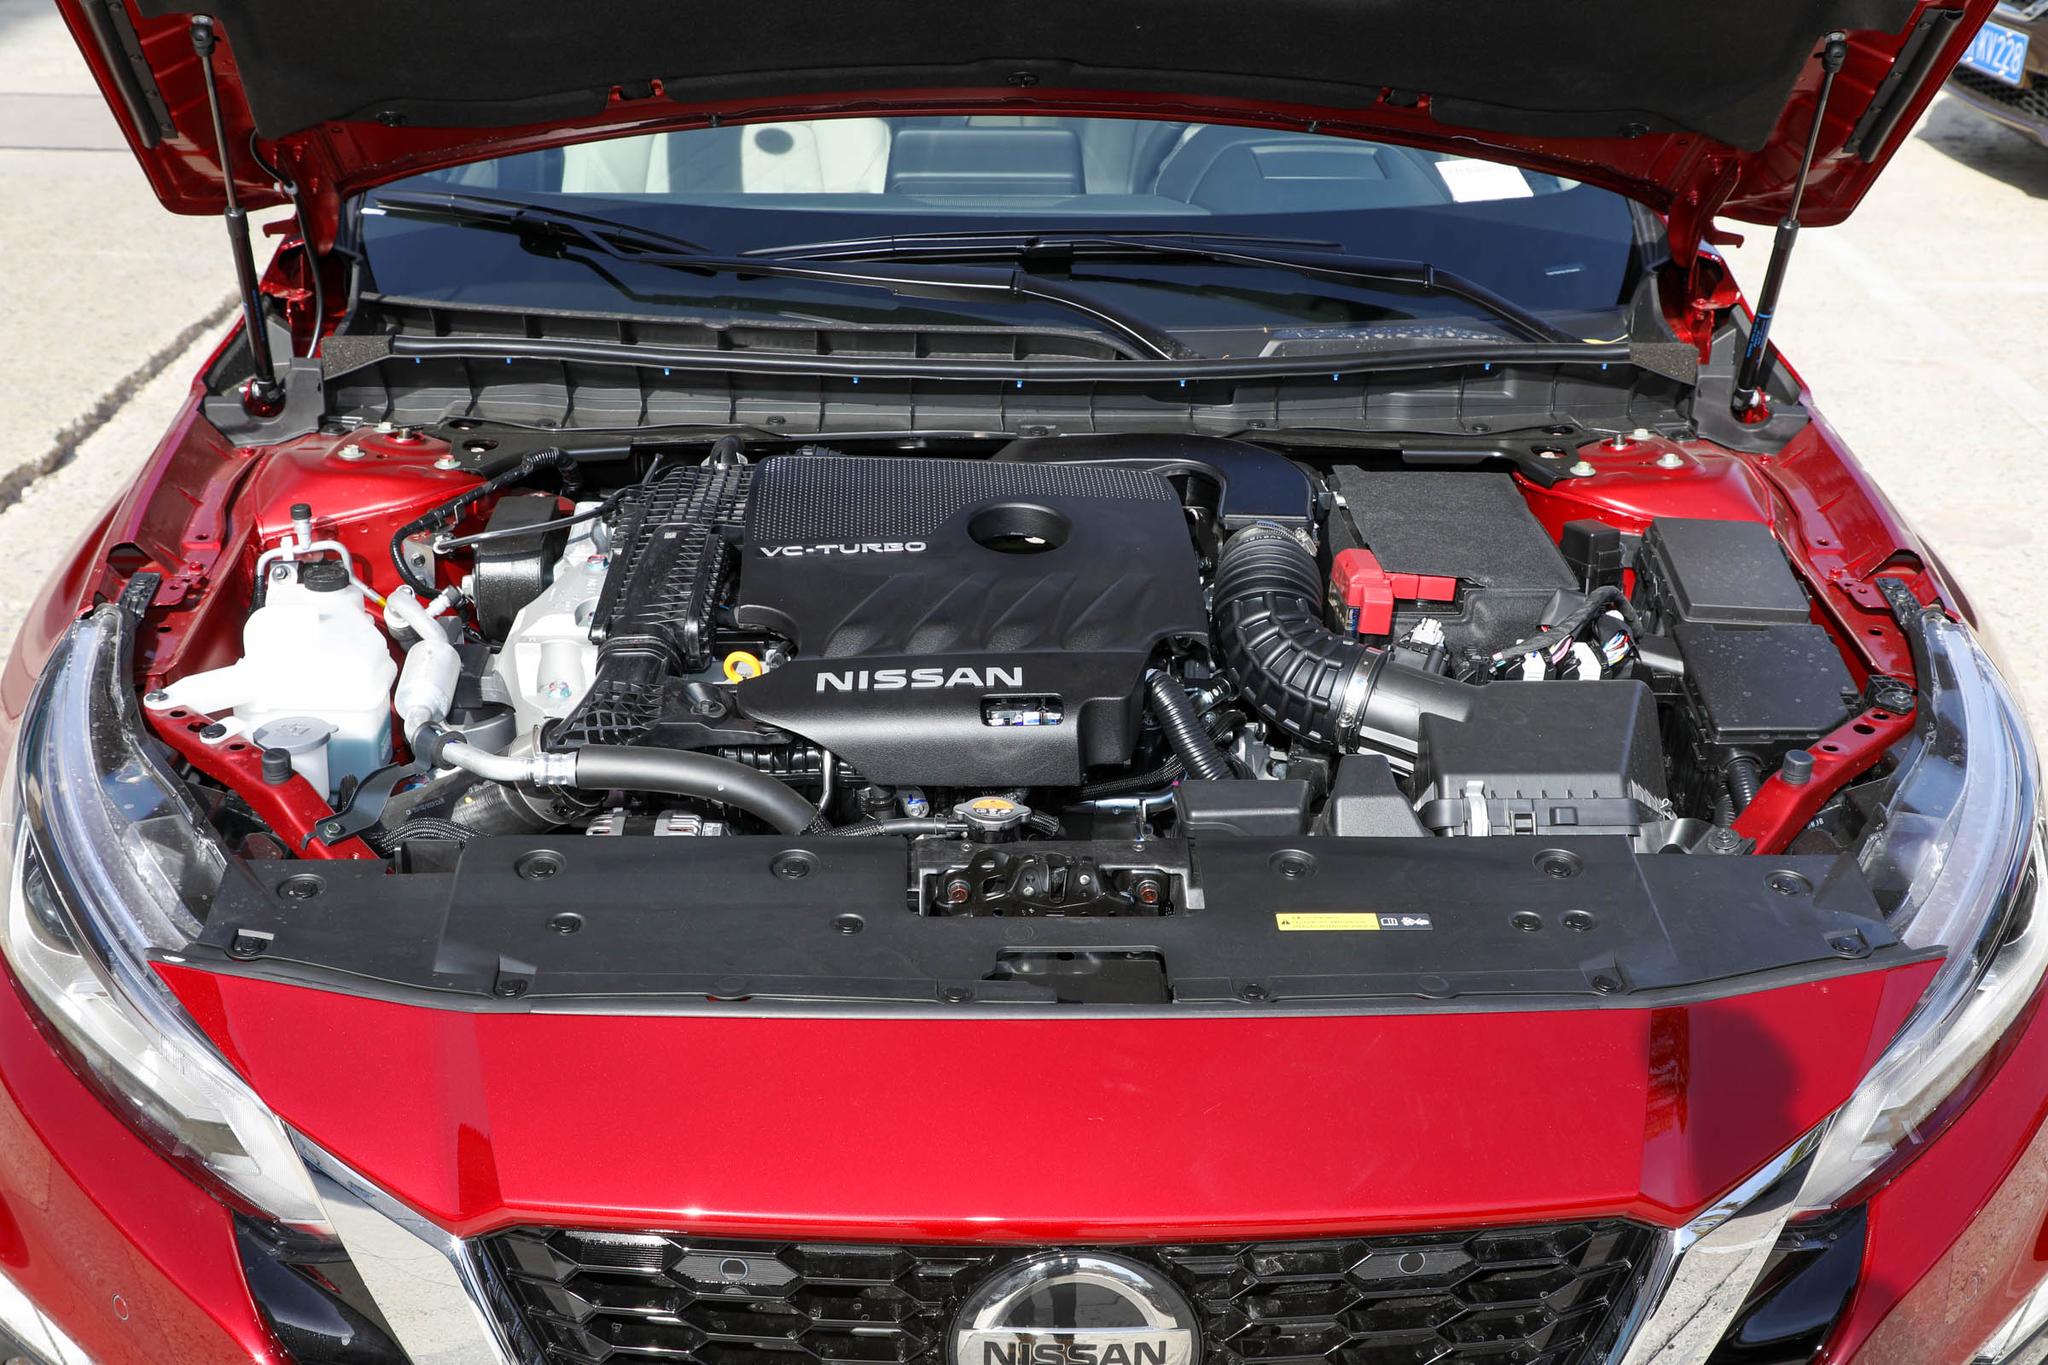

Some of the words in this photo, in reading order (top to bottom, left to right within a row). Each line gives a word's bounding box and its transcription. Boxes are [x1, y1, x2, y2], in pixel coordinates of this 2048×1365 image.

[760, 541, 927, 557] VC-TURBO
[816, 666, 1023, 693] NISSAN
[984, 1340, 1167, 1365] NISSAN
